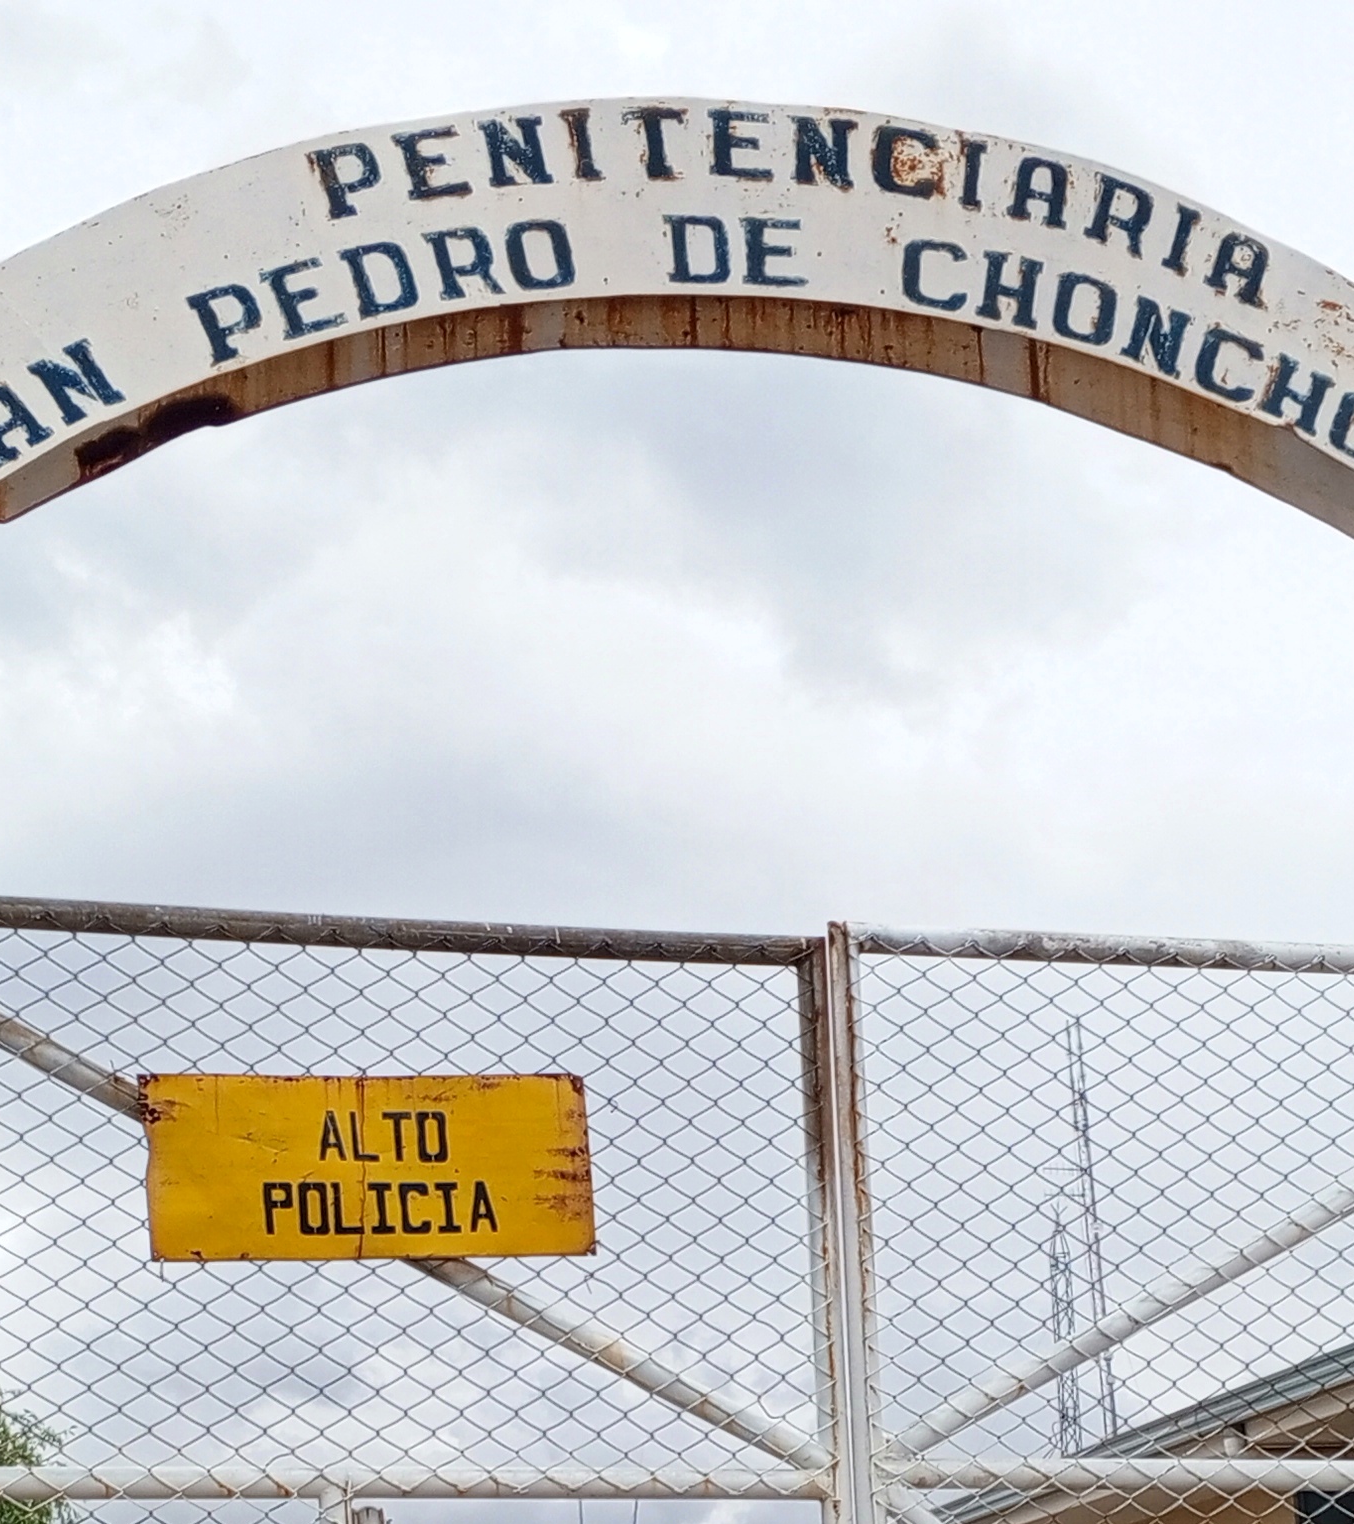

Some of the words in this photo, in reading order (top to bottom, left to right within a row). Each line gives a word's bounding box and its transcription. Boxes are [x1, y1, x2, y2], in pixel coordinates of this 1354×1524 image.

[306, 104, 1270, 309] PENITENCIARIA
[186, 218, 576, 367] PEDRO
[662, 214, 808, 288] DE
[319, 1109, 450, 1163] ALTO
[262, 1181, 498, 1235] POLICIA
